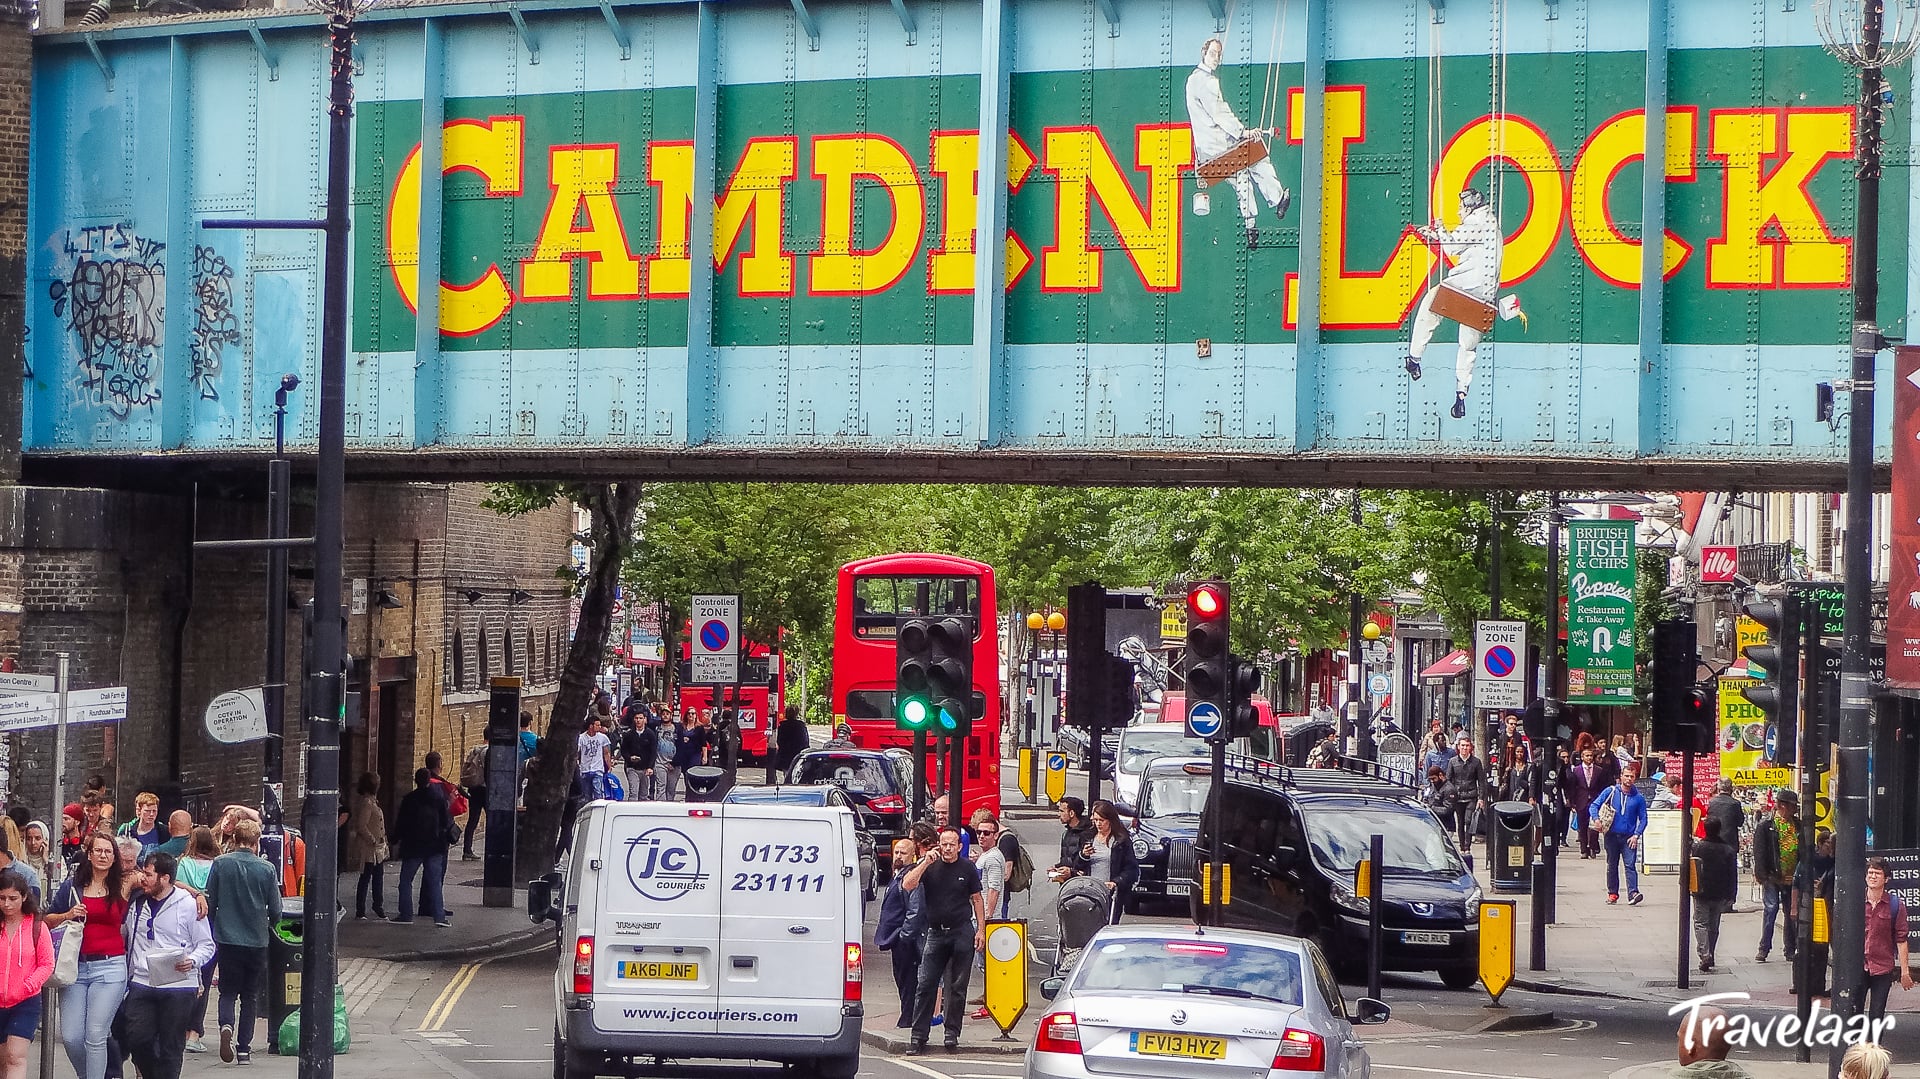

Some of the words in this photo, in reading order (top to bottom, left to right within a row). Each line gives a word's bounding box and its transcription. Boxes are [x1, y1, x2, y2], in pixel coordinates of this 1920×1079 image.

[386, 112, 1194, 336] CAMDEN
[1282, 83, 1857, 330] LOCK
[1575, 527, 1629, 539] BRITISH
[1575, 539, 1629, 558] FISH
[1575, 557, 1587, 569] &
[1589, 557, 1629, 569] CHIPS
[1703, 551, 1736, 578] illy
[1571, 572, 1633, 603] Poppies
[694, 598, 736, 606] Controlled
[700, 607, 729, 617] ZONE
[1577, 605, 1626, 615] Restaurant
[1585, 616, 1602, 624] Take
[1604, 616, 1626, 626] Away
[1479, 623, 1523, 632] Controlled
[1485, 633, 1516, 643] ZONE
[1587, 657, 1594, 667] 2
[1595, 657, 1614, 667] Min
[12, 677, 32, 686] Centre
[213, 714, 248, 726] OPERATION
[1734, 770, 1758, 780] ALL
[1765, 770, 1784, 779] £10
[639, 838, 688, 879] jc
[741, 844, 820, 864] 01733
[1891, 869, 1920, 880] ESTS
[656, 881, 706, 890] COURIERS
[731, 872, 825, 893] 231111
[615, 921, 662, 930] TRANSIT
[629, 963, 662, 976] AK61
[665, 964, 693, 978] JNF
[623, 1007, 798, 1022] www.jccouriers.com
[1144, 1035, 1182, 1051] FV13
[1187, 1037, 1220, 1055] HYZ
